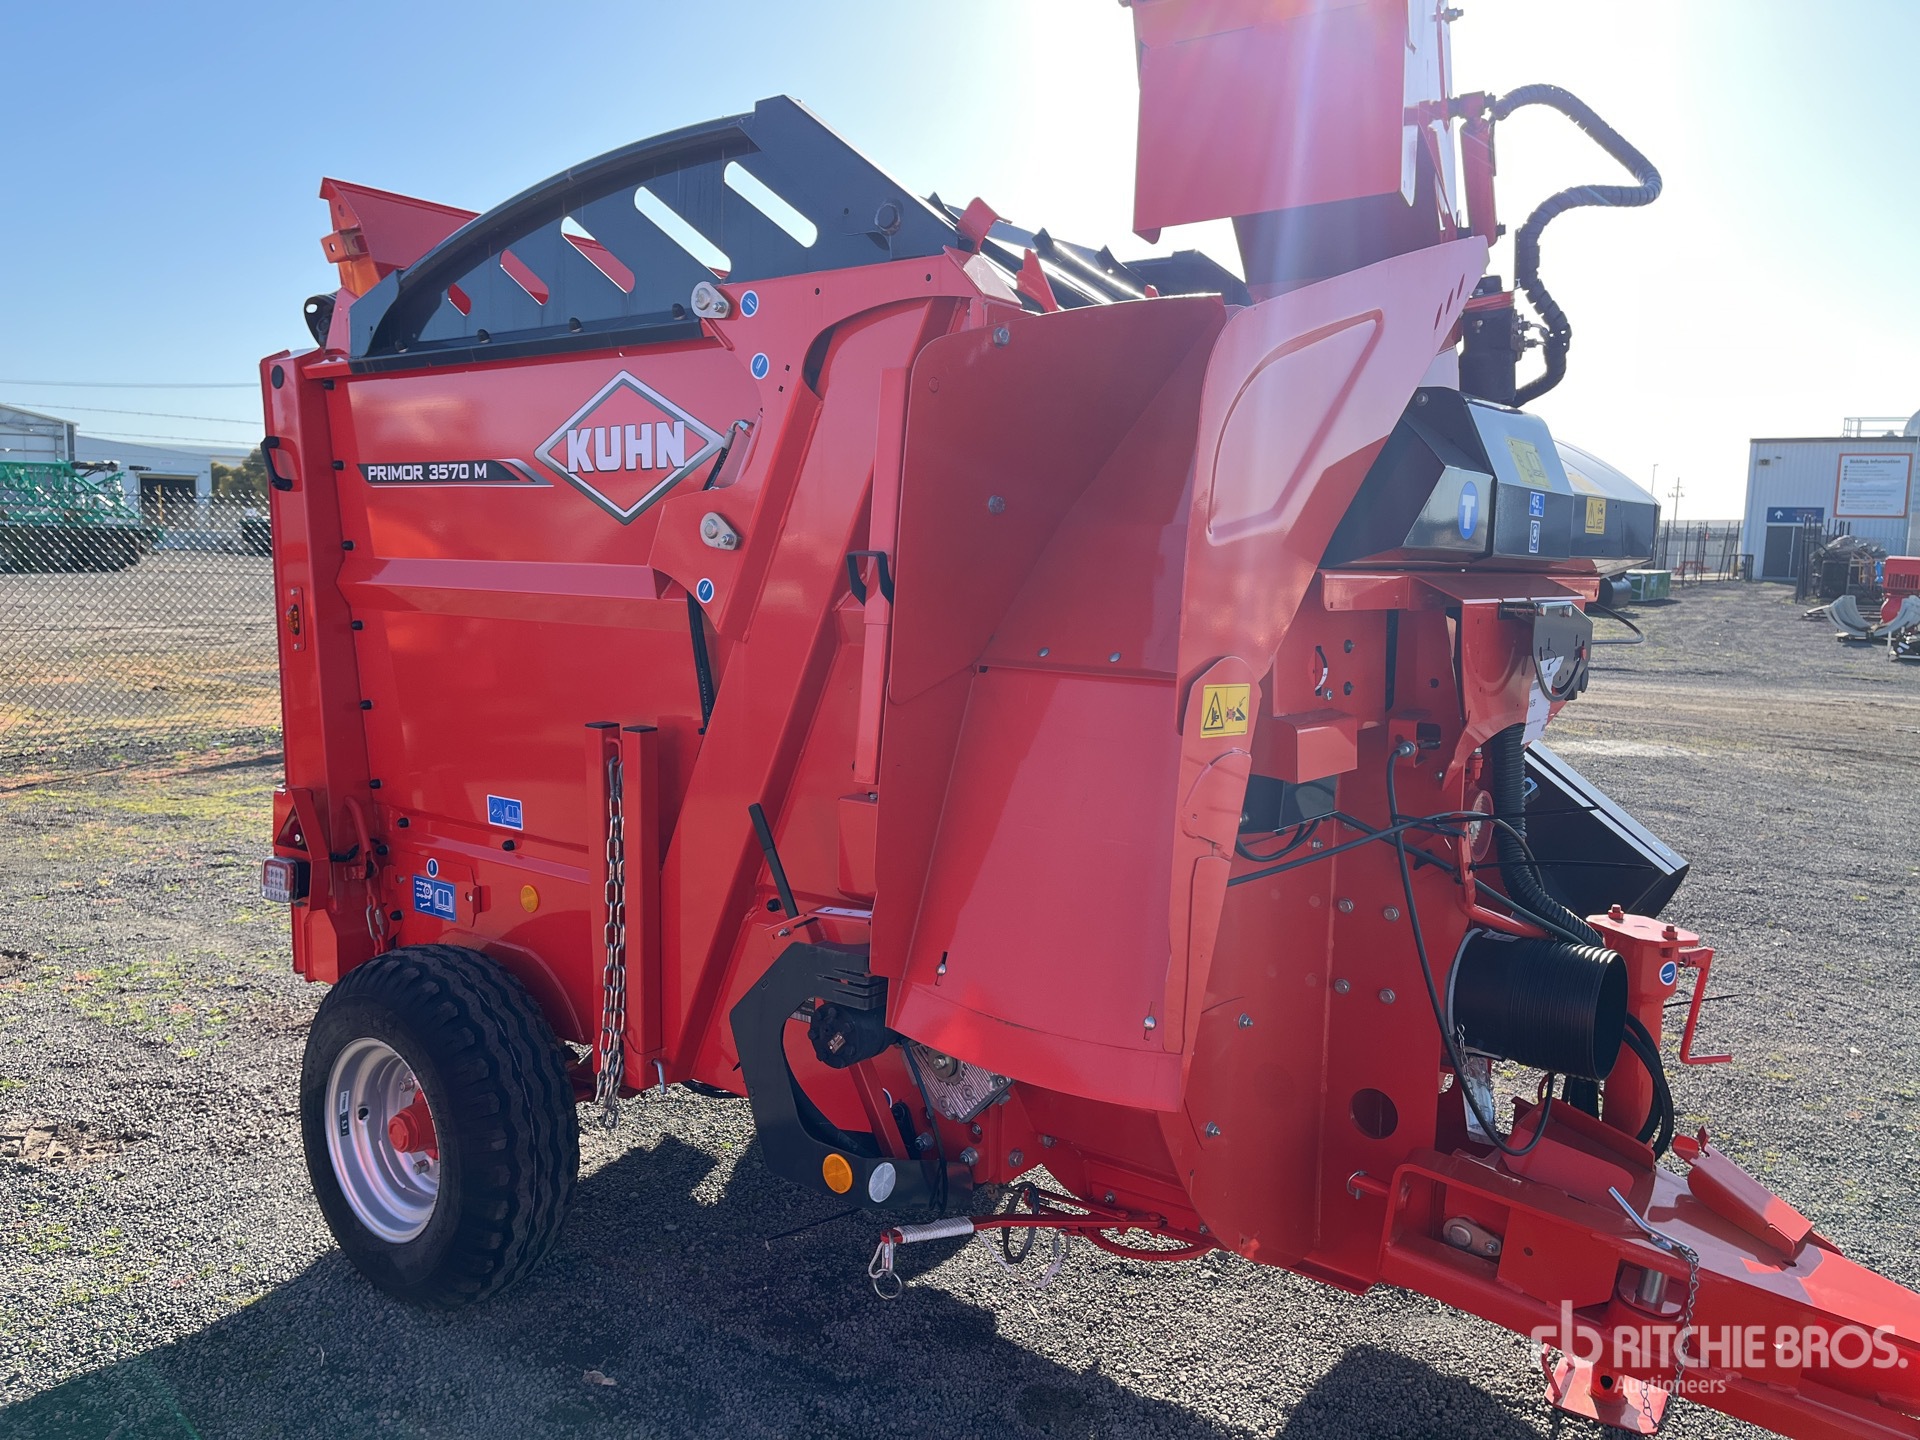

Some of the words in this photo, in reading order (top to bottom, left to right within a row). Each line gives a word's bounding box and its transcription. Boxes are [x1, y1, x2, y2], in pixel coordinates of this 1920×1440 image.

[567, 420, 685, 474] KUHN
[368, 465, 423, 481] PRIMOR
[428, 463, 470, 480] 3570
[474, 463, 487, 479] M
[1532, 495, 1540, 508] 45
